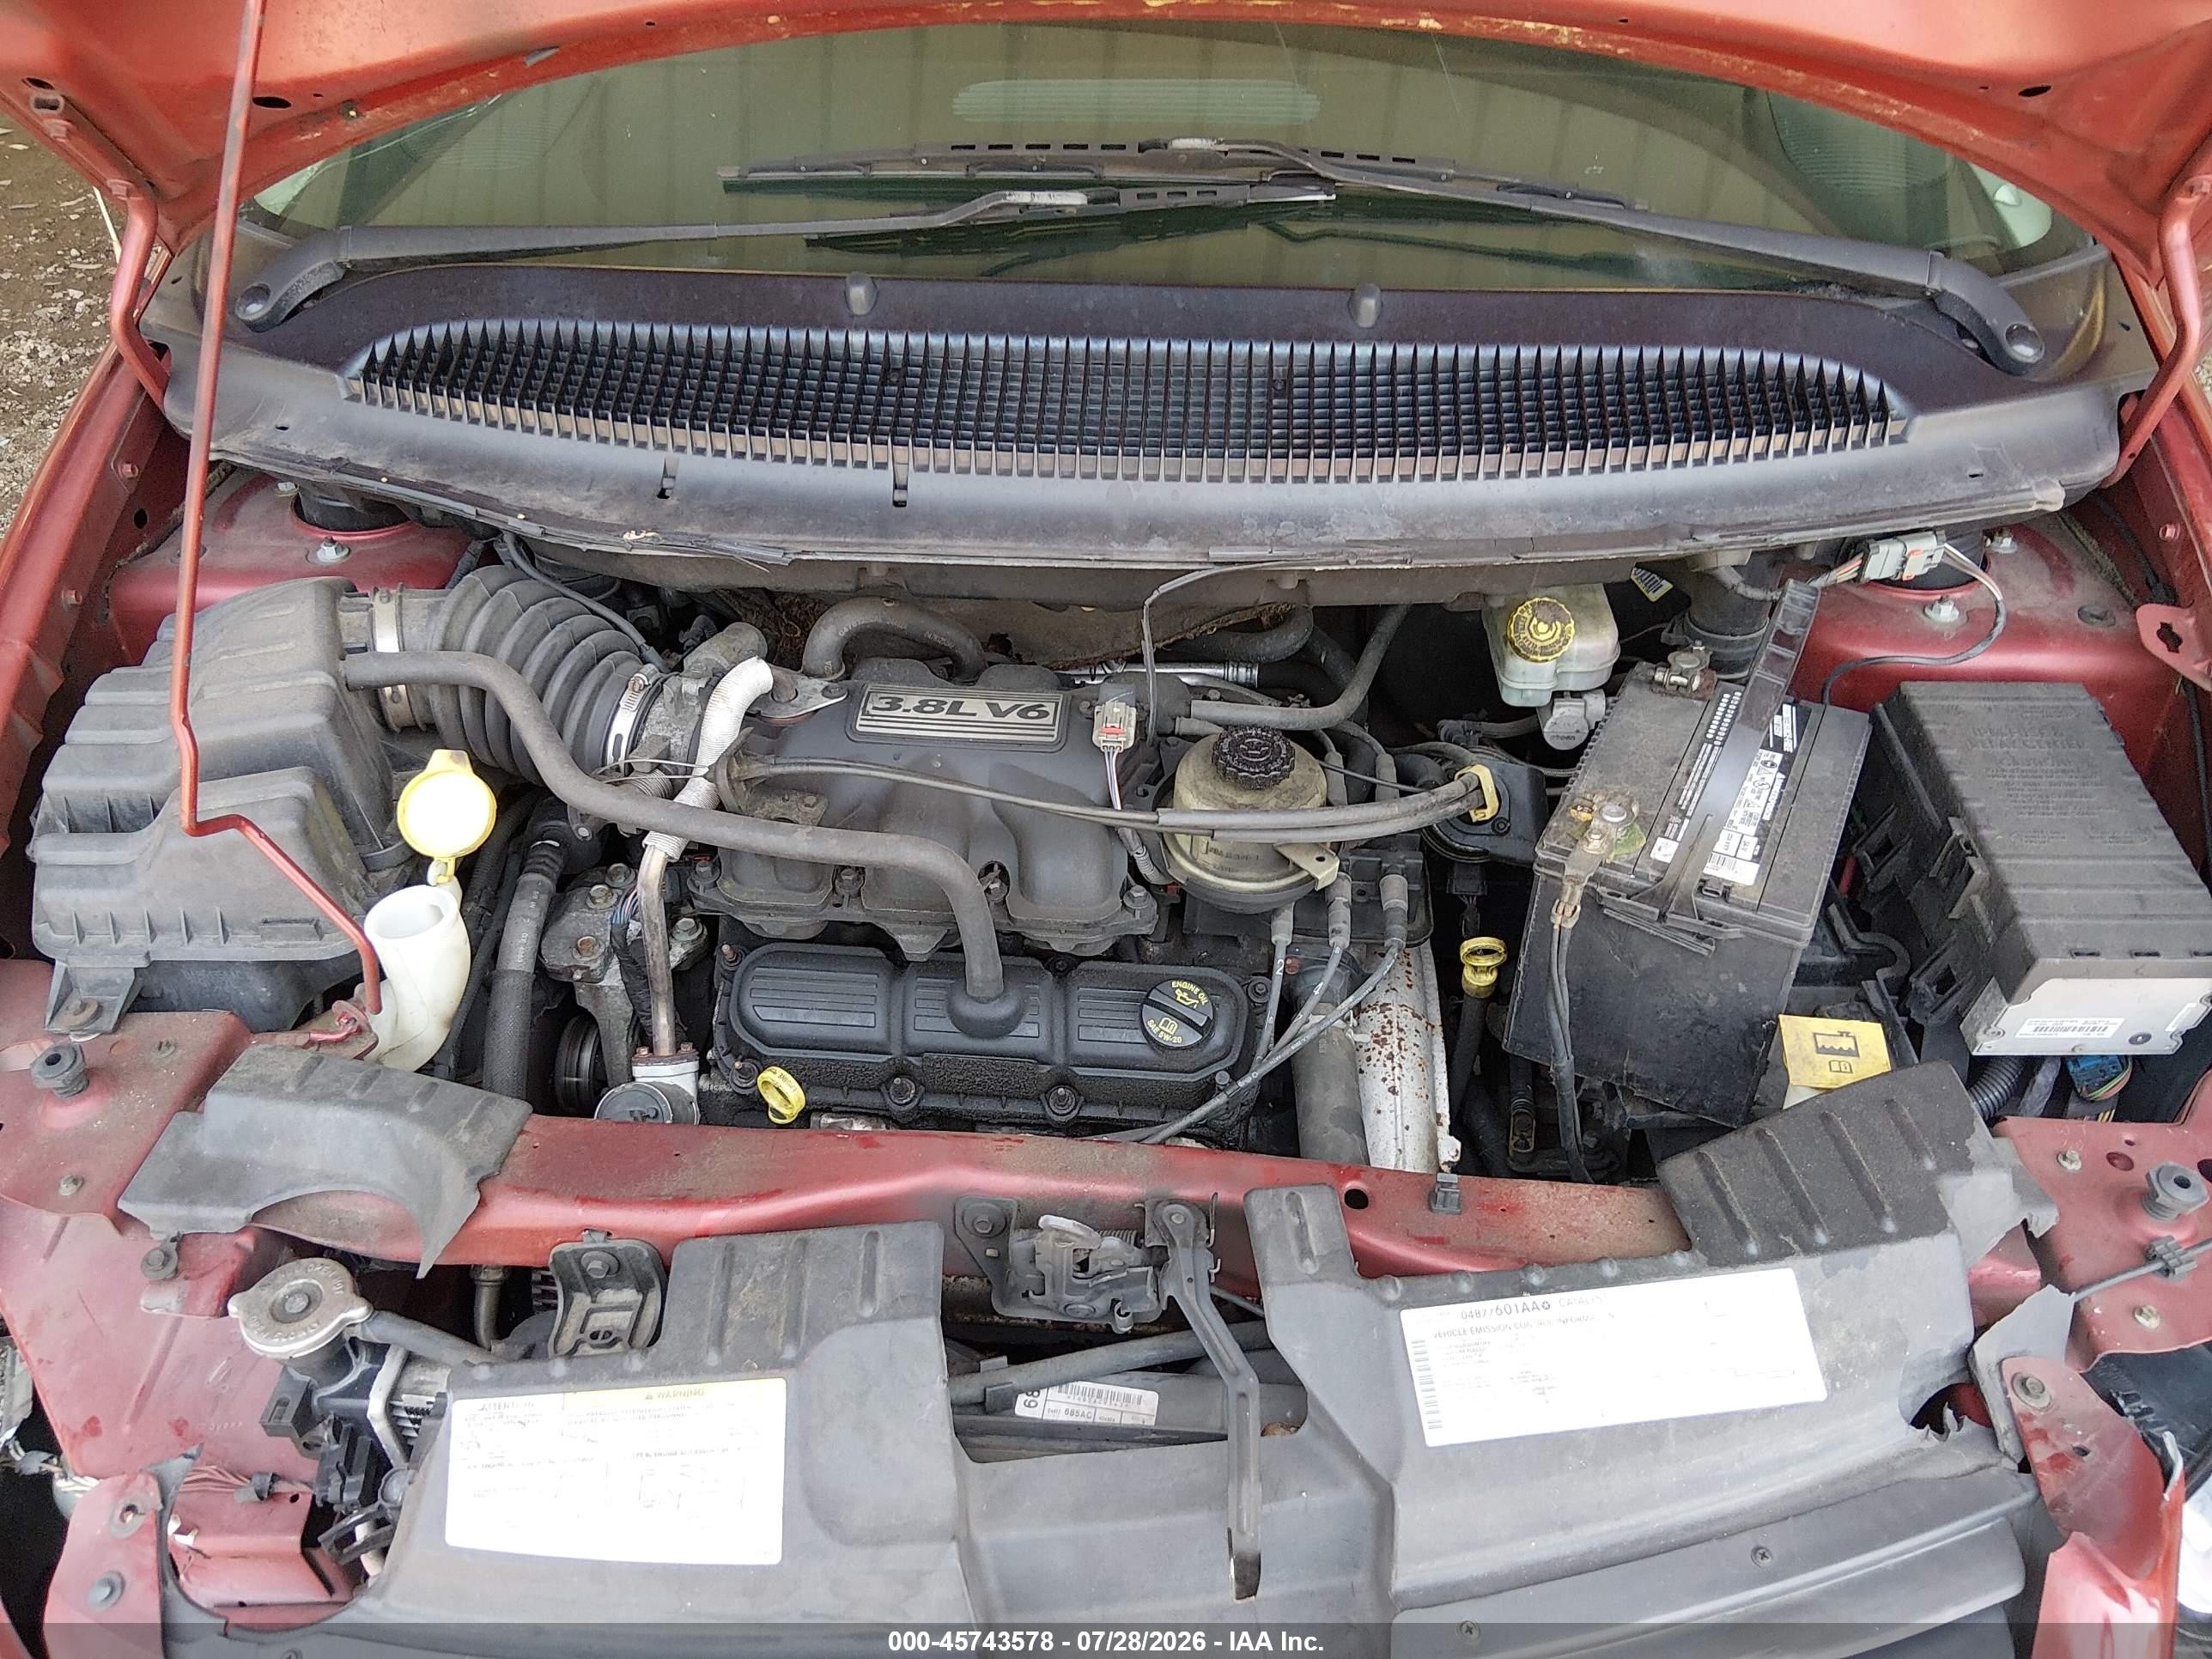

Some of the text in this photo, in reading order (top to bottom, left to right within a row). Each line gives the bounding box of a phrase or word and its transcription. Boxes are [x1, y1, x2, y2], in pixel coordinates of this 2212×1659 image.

[871, 696, 1050, 720] 3.8L V6
[1276, 959, 1284, 975] 2
[1172, 981, 1208, 1006] ENGINE OIL
[1313, 981, 1324, 995] 4
[1147, 1019, 1182, 1043] SAE 5W-20
[657, 1388, 705, 1401] WARNING
